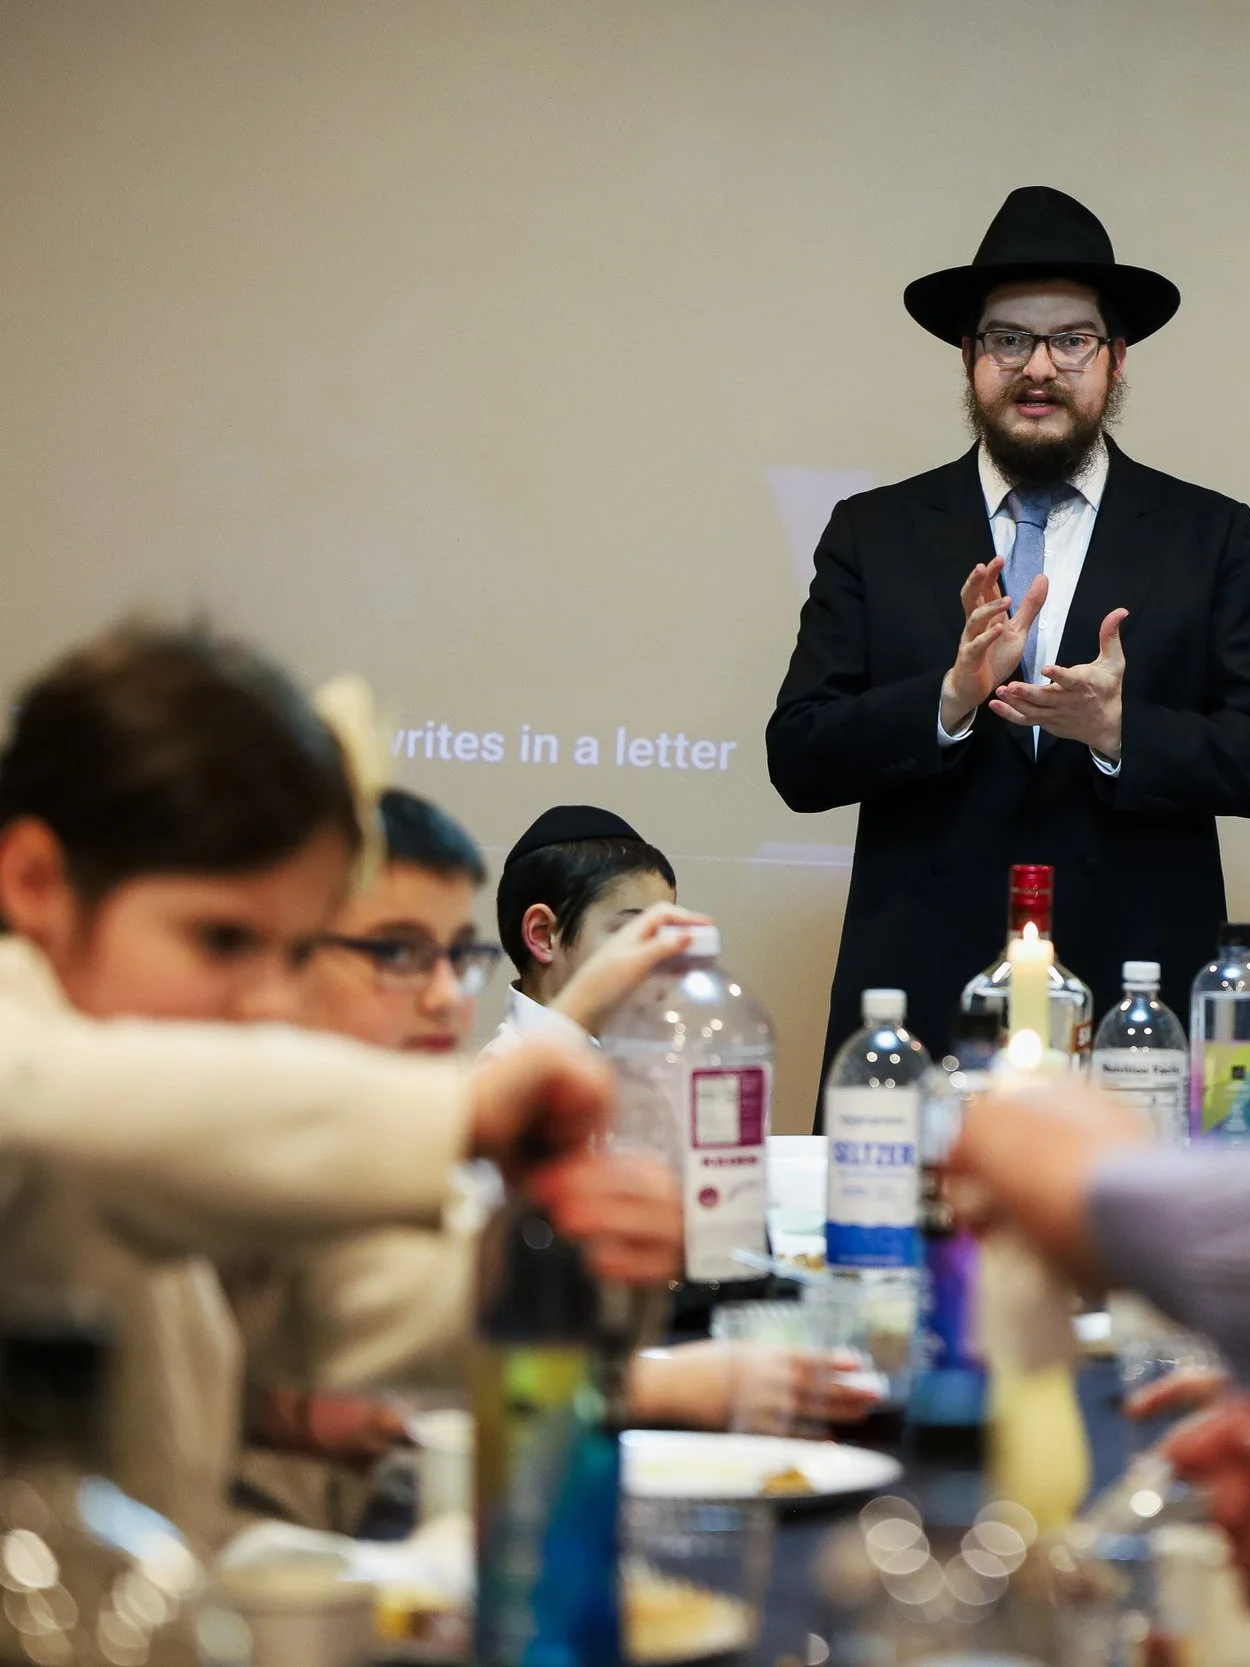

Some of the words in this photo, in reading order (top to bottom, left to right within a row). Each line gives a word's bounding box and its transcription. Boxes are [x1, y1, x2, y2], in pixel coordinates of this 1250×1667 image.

[520, 724, 558, 764] in
[573, 736, 599, 766] a
[615, 726, 738, 770] letter
